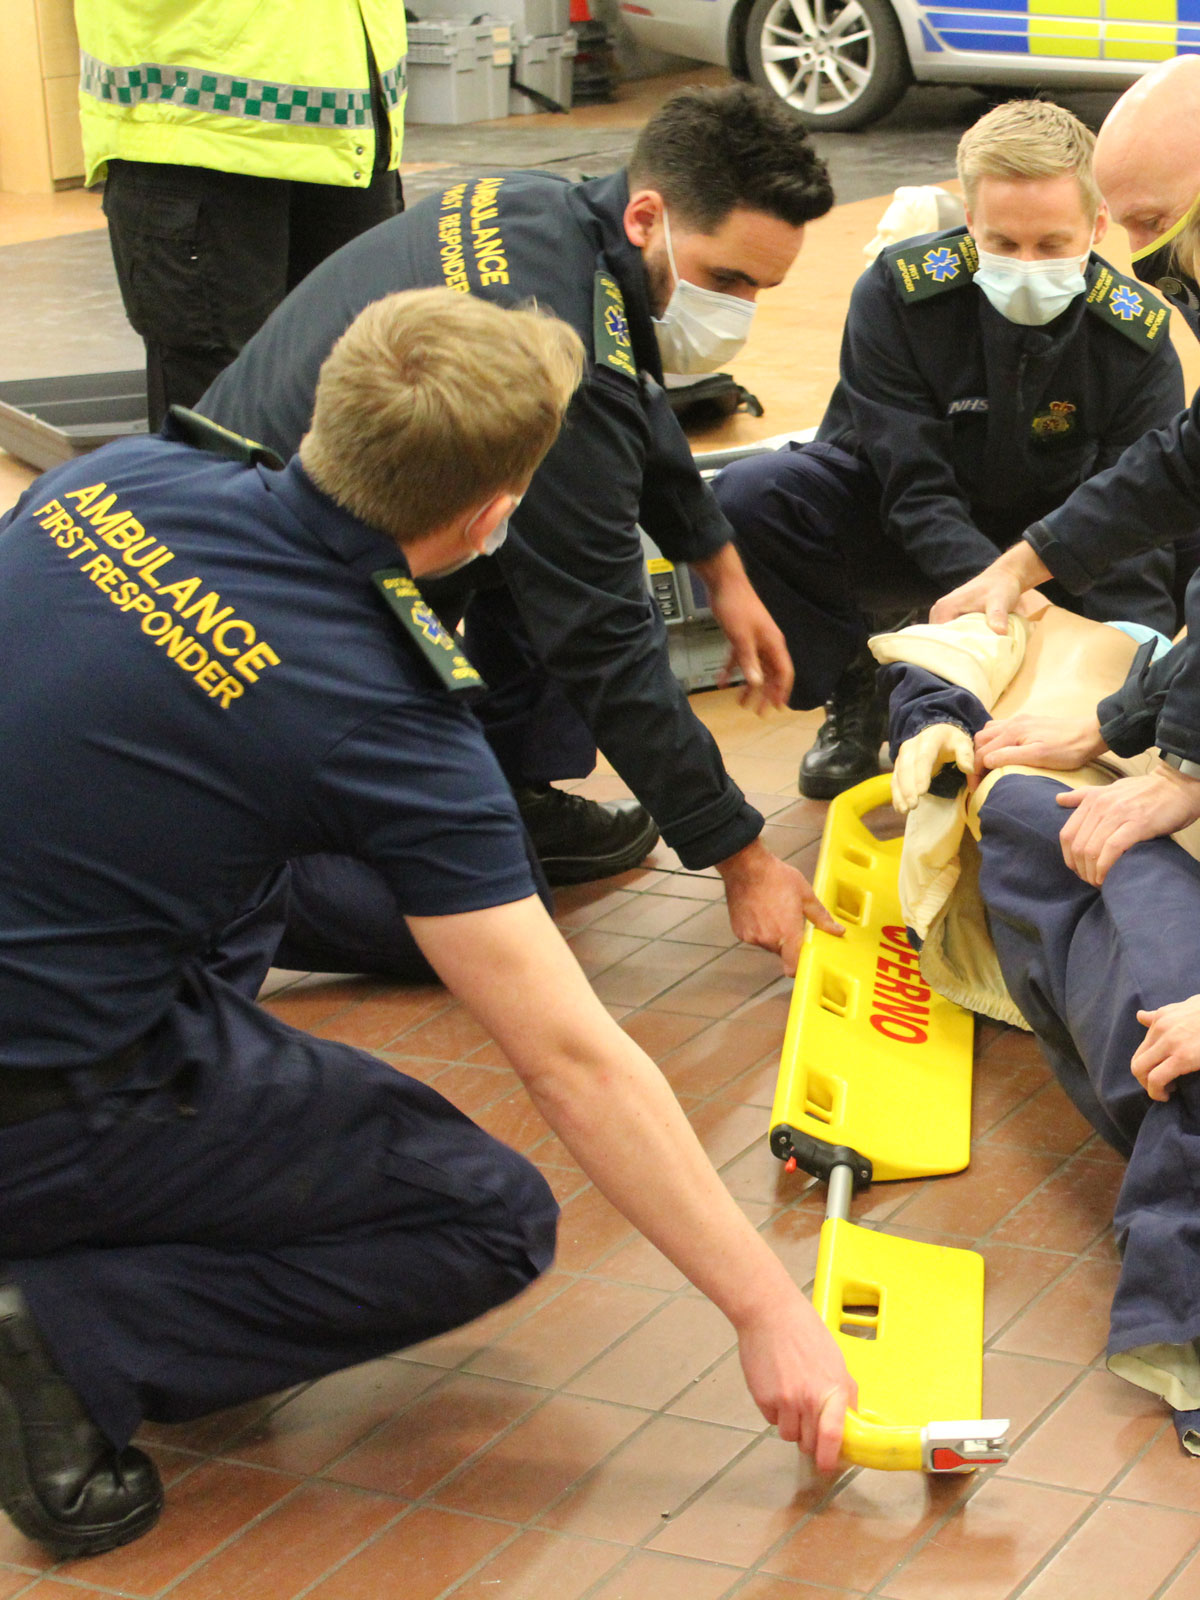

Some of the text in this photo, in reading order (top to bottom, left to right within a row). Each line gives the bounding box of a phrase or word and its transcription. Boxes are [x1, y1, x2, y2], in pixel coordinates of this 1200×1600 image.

[469, 177, 510, 286] AMBULANCE
[947, 399, 989, 414] NHS
[33, 499, 244, 709] FIRST RESPONDER
[65, 482, 281, 683] AMBULANCE
